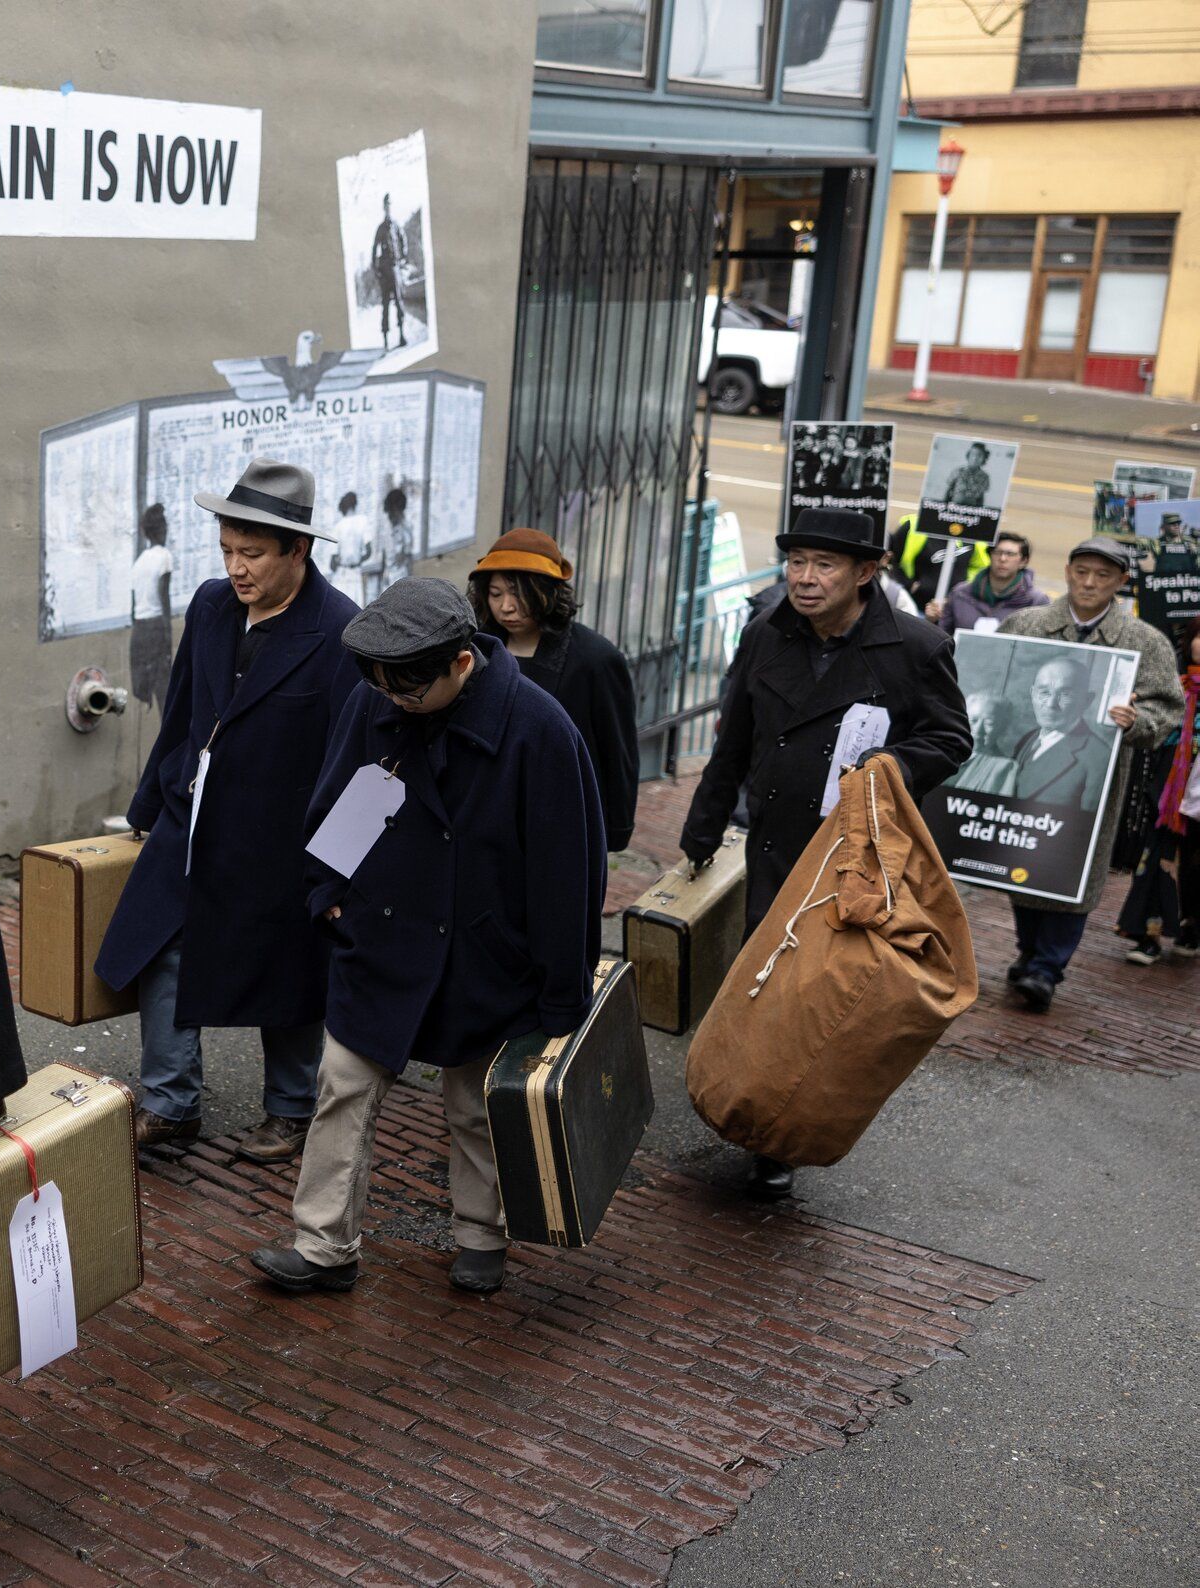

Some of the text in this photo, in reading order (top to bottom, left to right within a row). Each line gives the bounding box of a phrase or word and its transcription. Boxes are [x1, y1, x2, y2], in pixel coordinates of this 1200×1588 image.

[82, 129, 119, 203] IS
[135, 132, 239, 207] NOW
[222, 396, 372, 429] HONOR ROLL
[792, 494, 886, 511] Stop Repeating
[922, 497, 999, 520] Stop Repeating
[1145, 573, 1200, 591] Speakin
[1166, 589, 1200, 603] to Po
[946, 796, 1064, 837] We already
[960, 820, 1039, 850] did this
